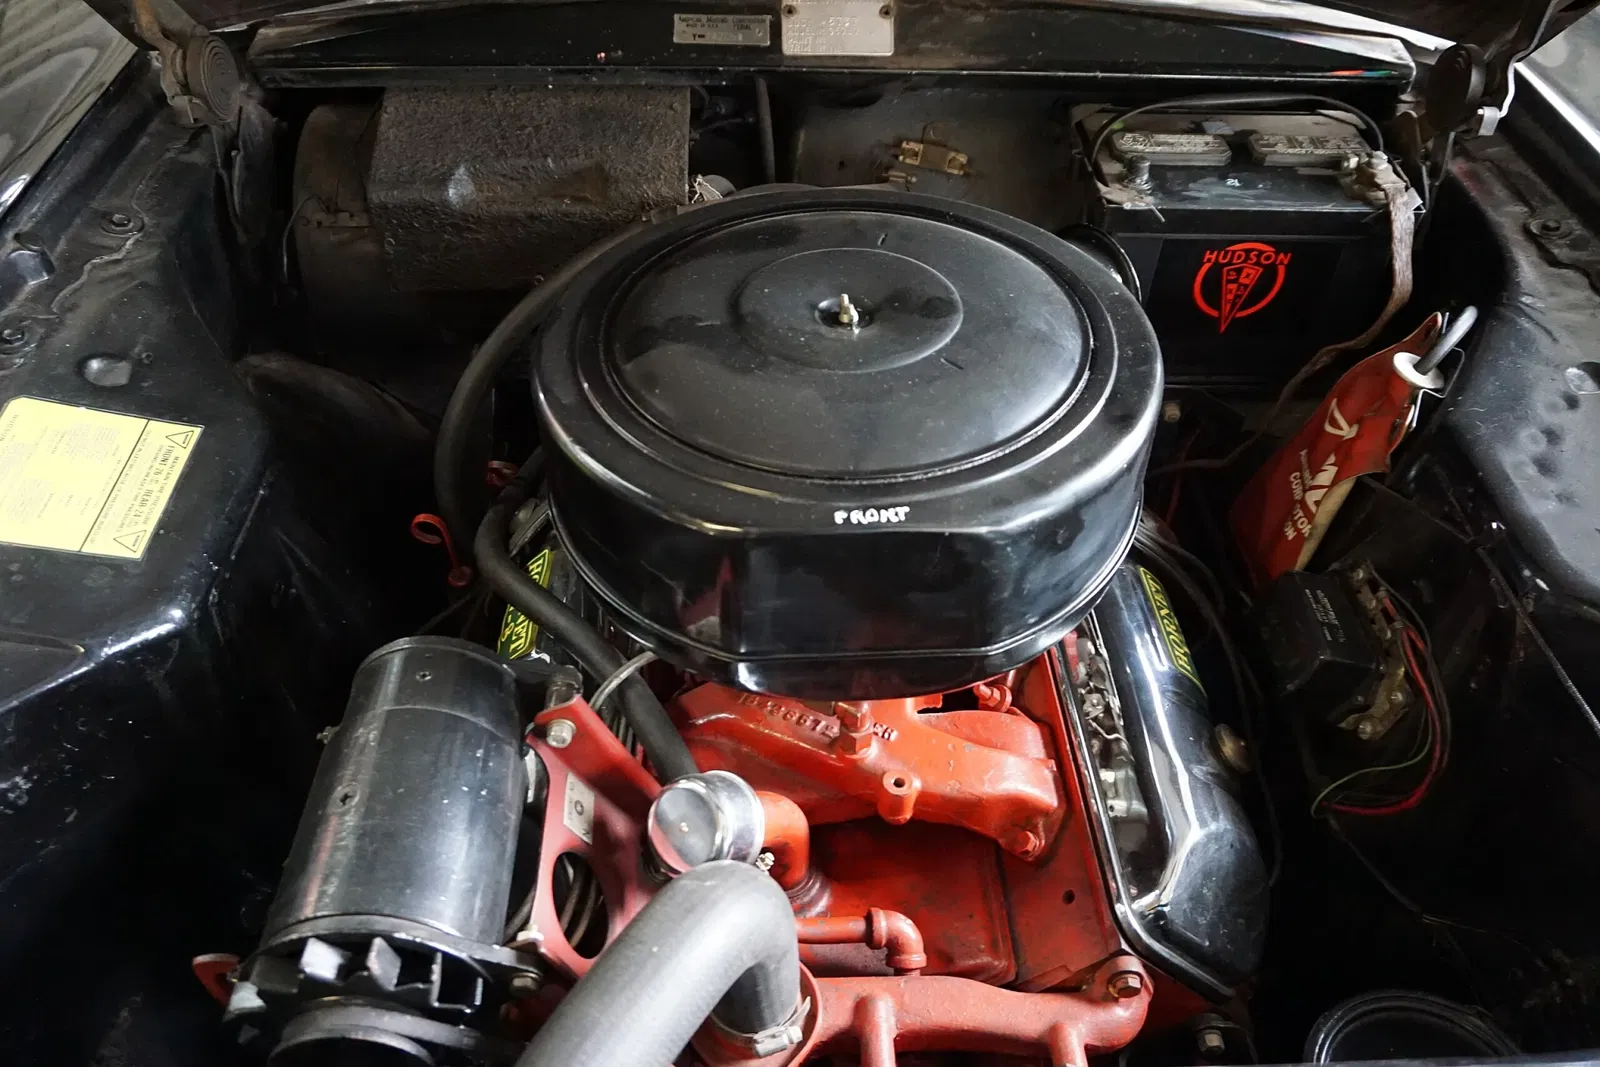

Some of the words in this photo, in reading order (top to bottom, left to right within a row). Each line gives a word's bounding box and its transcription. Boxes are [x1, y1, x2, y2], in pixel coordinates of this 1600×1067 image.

[1203, 250, 1291, 265] HUDSON
[834, 506, 910, 524] FRONT
[1146, 574, 1193, 674] HORNET
